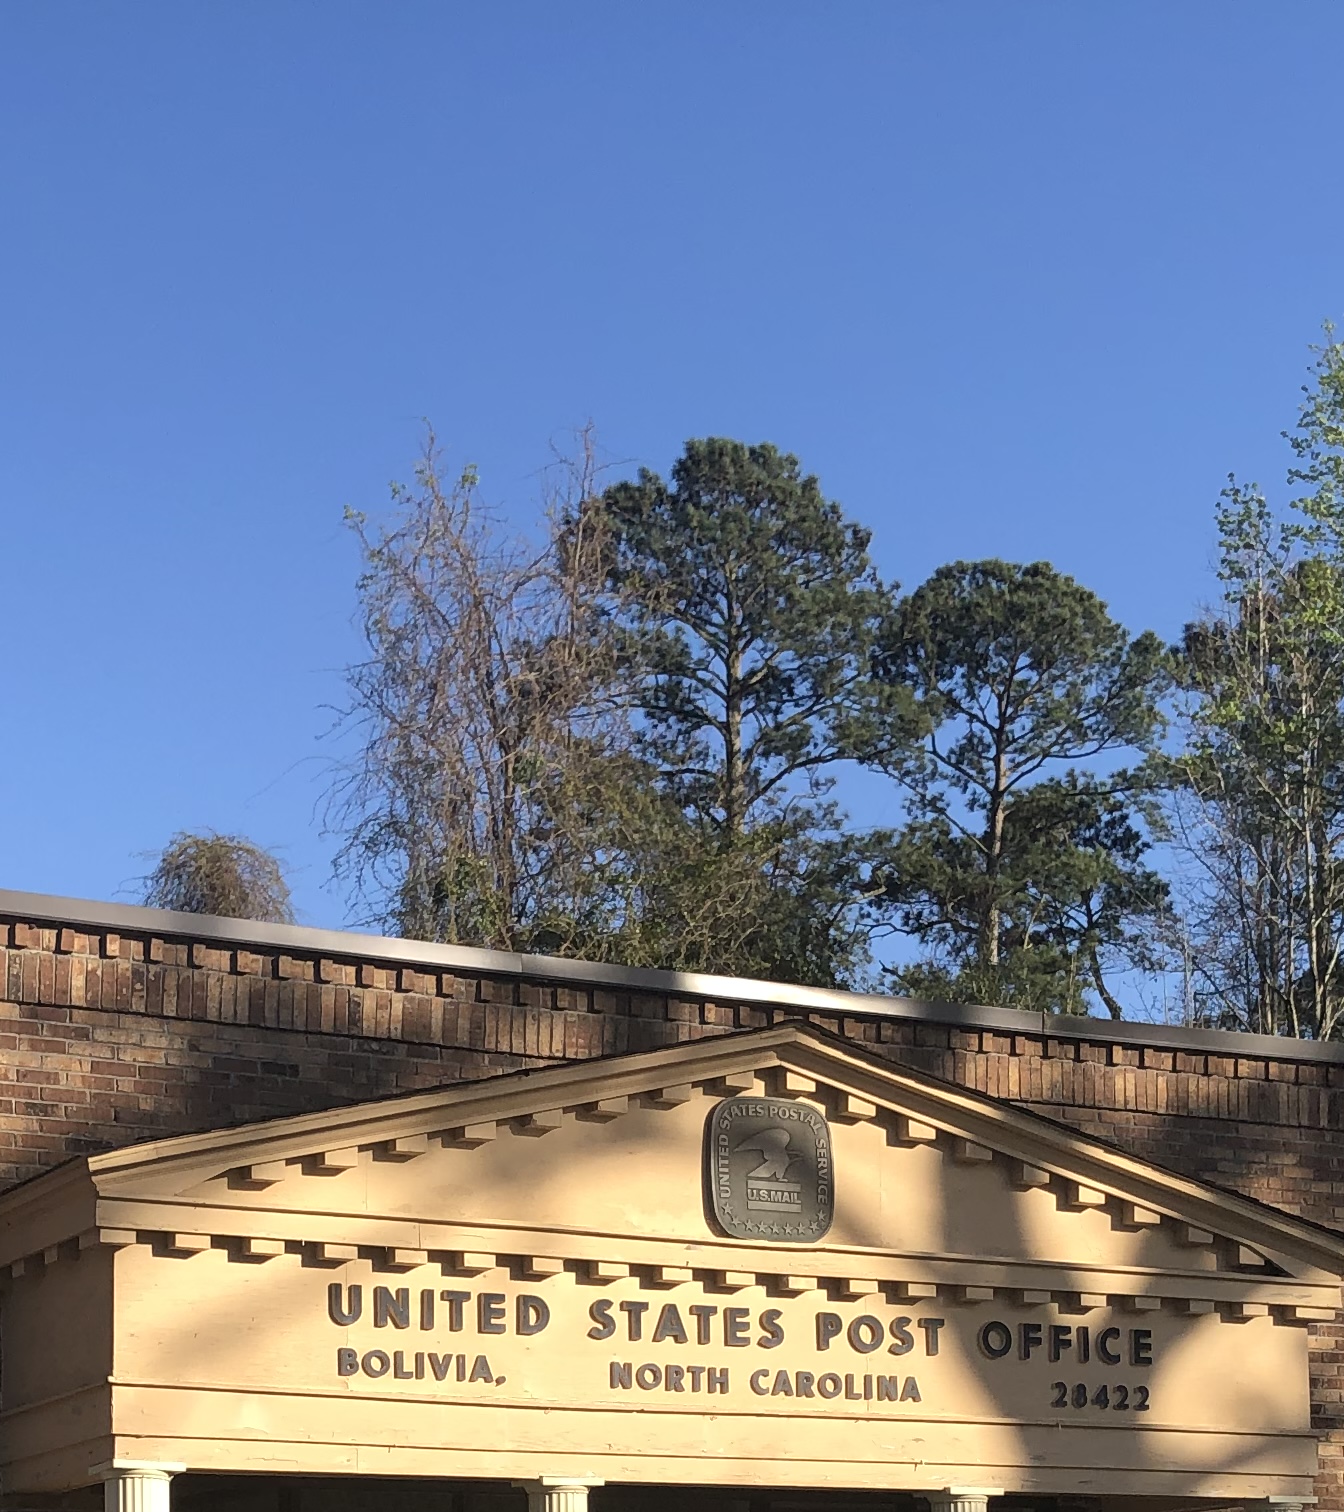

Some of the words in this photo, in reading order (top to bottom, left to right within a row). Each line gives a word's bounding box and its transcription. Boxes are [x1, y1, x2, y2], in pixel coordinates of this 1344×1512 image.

[720, 1104, 764, 1130] STATES
[768, 1106, 822, 1135] POSTAL
[719, 1134, 731, 1198] UNITED
[815, 1138, 828, 1204] SERVICE
[327, 1283, 550, 1336] UNITED
[586, 1298, 785, 1348] STATES
[815, 1311, 946, 1357] POST
[977, 1320, 1153, 1367] OFFICE
[337, 1347, 507, 1387] BOLIVIA,
[609, 1361, 729, 1394] NORTH
[750, 1368, 922, 1403] CAROLINA
[1049, 1381, 1151, 1411] 28422
